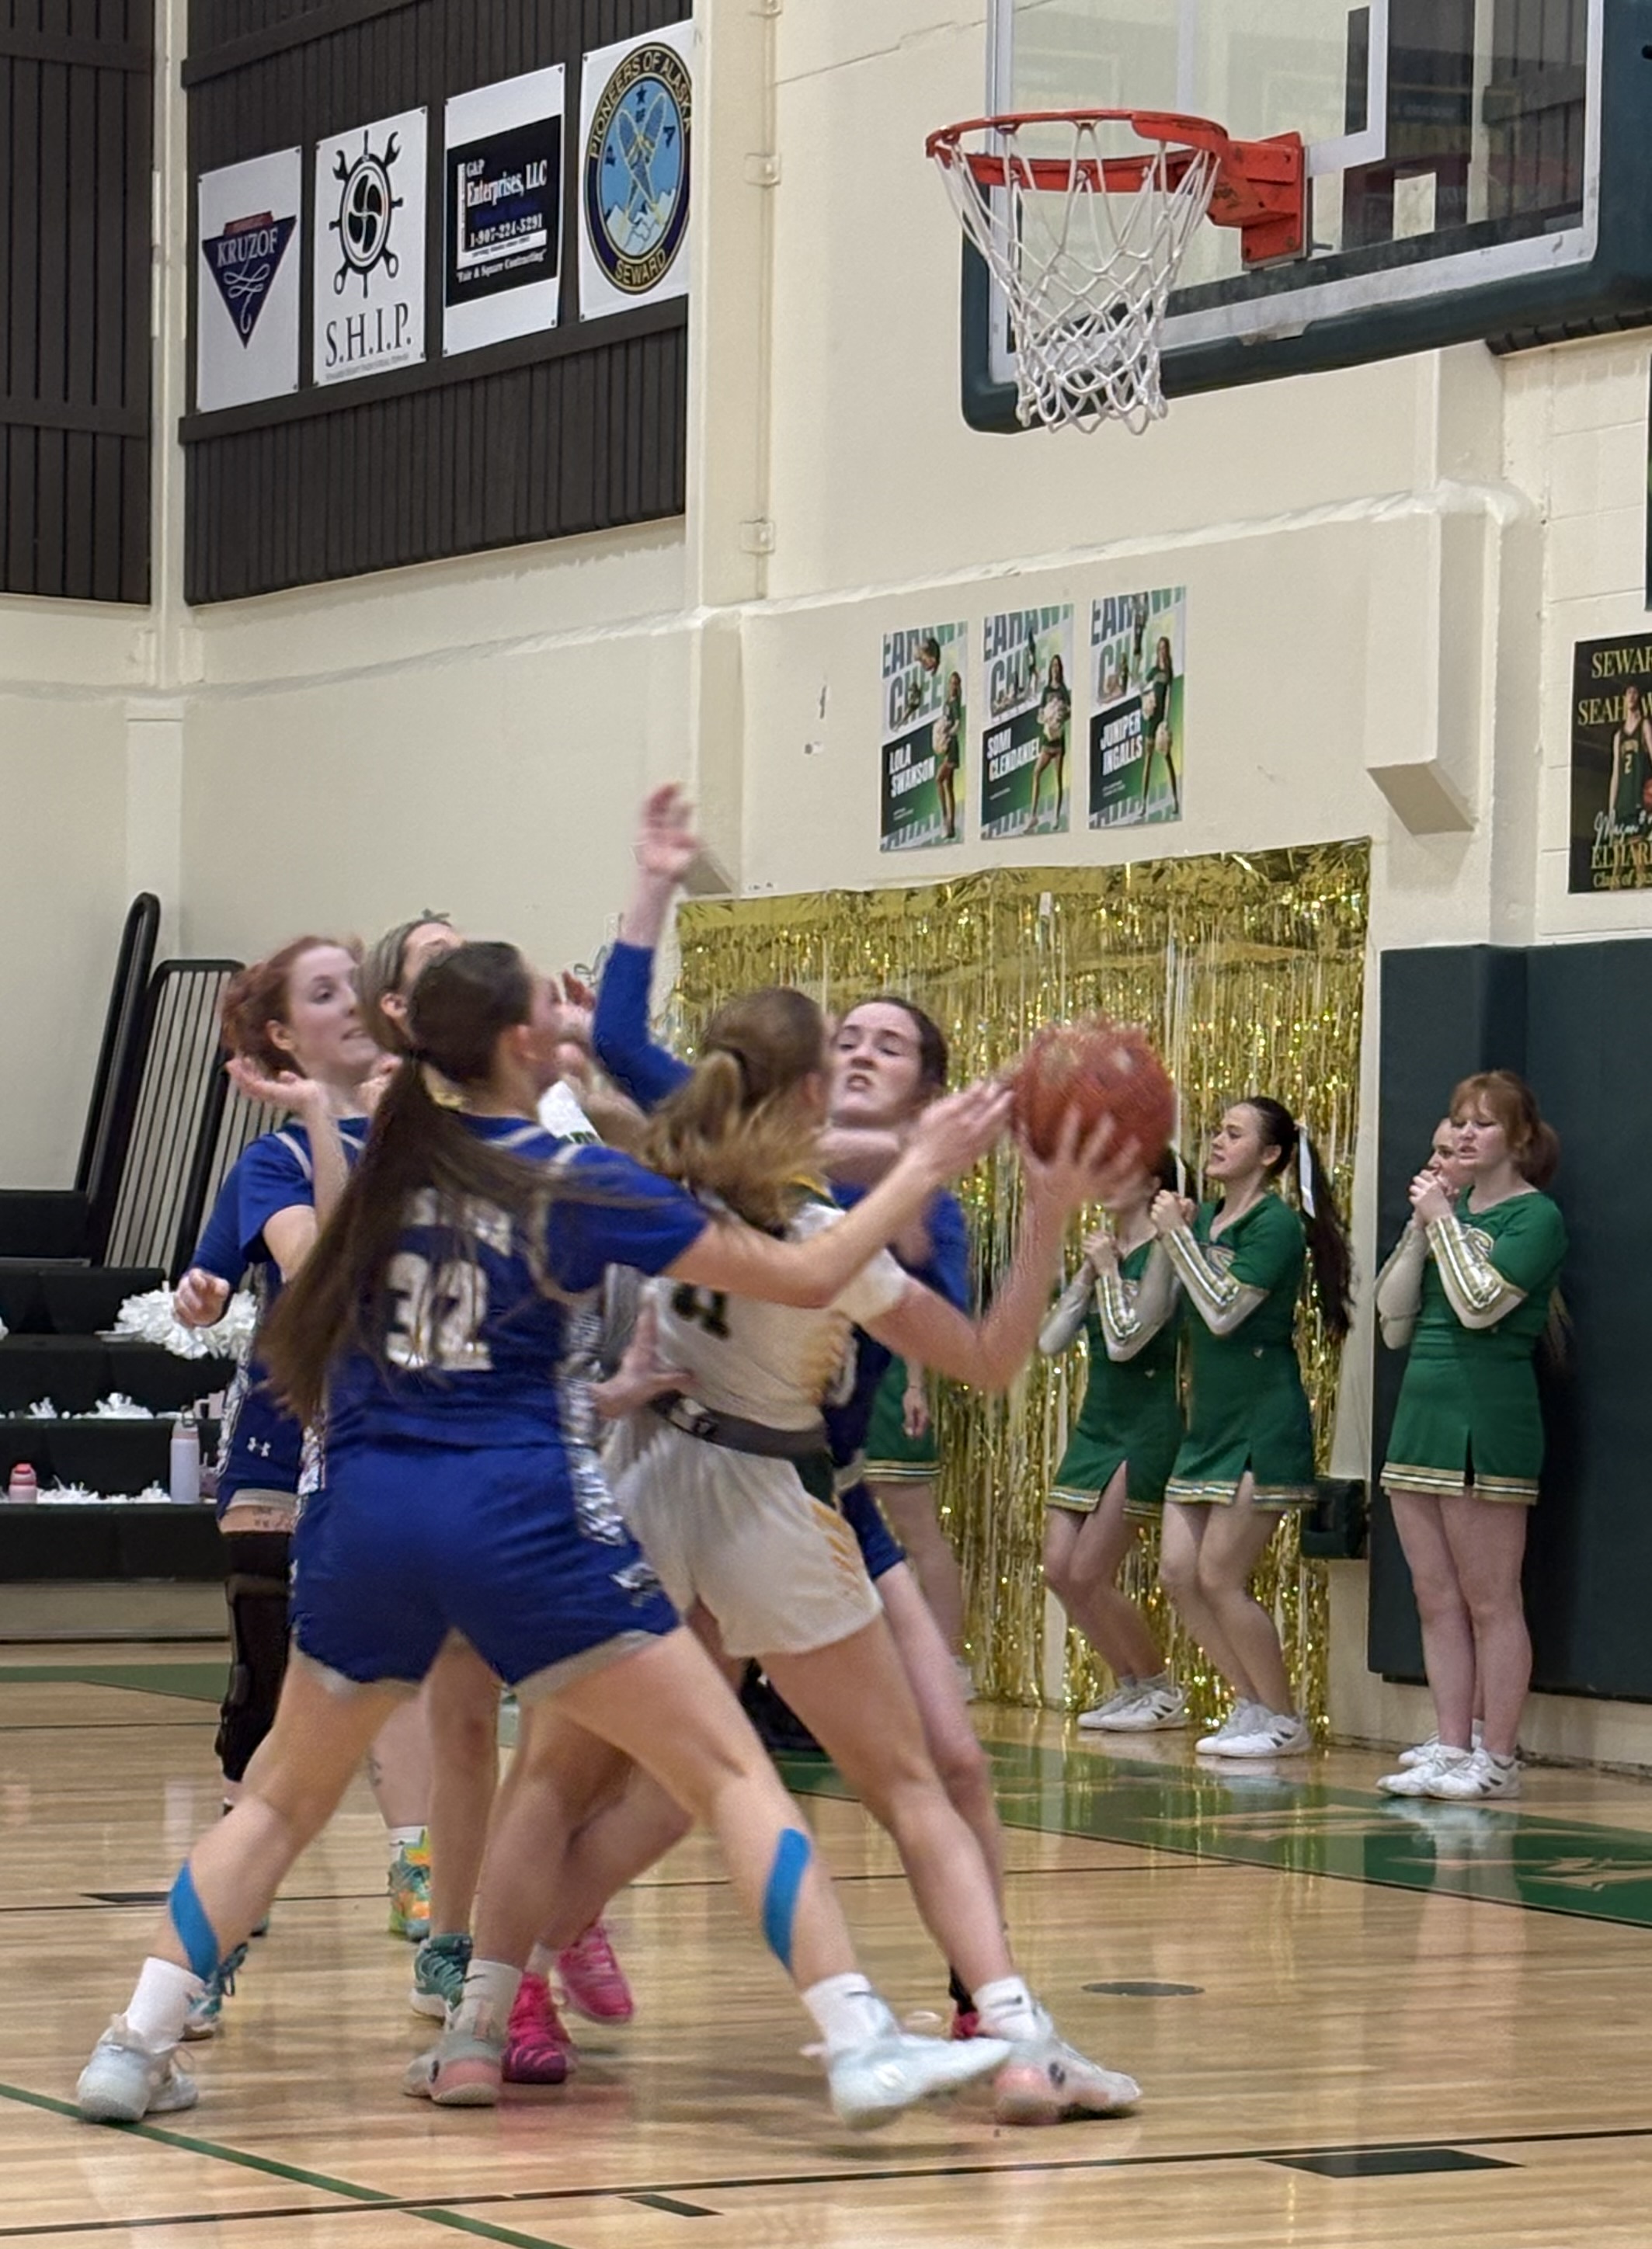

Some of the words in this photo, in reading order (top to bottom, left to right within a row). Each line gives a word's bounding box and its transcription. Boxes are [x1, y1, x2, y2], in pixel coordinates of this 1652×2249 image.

[590, 57, 641, 158] PIONEERS
[642, 51, 661, 71] OF
[467, 171, 524, 207] Enterprises,
[526, 159, 548, 190] LLC
[217, 228, 278, 267] KRUZOF
[615, 248, 666, 285] SEWARD
[325, 302, 412, 367] S.H.I.P.
[1100, 708, 1141, 751] JUNIPER
[889, 743, 911, 775] LOLA
[1102, 734, 1143, 776] INGALLS
[891, 756, 935, 798] SWANSON
[386, 1252, 495, 1372] 32
